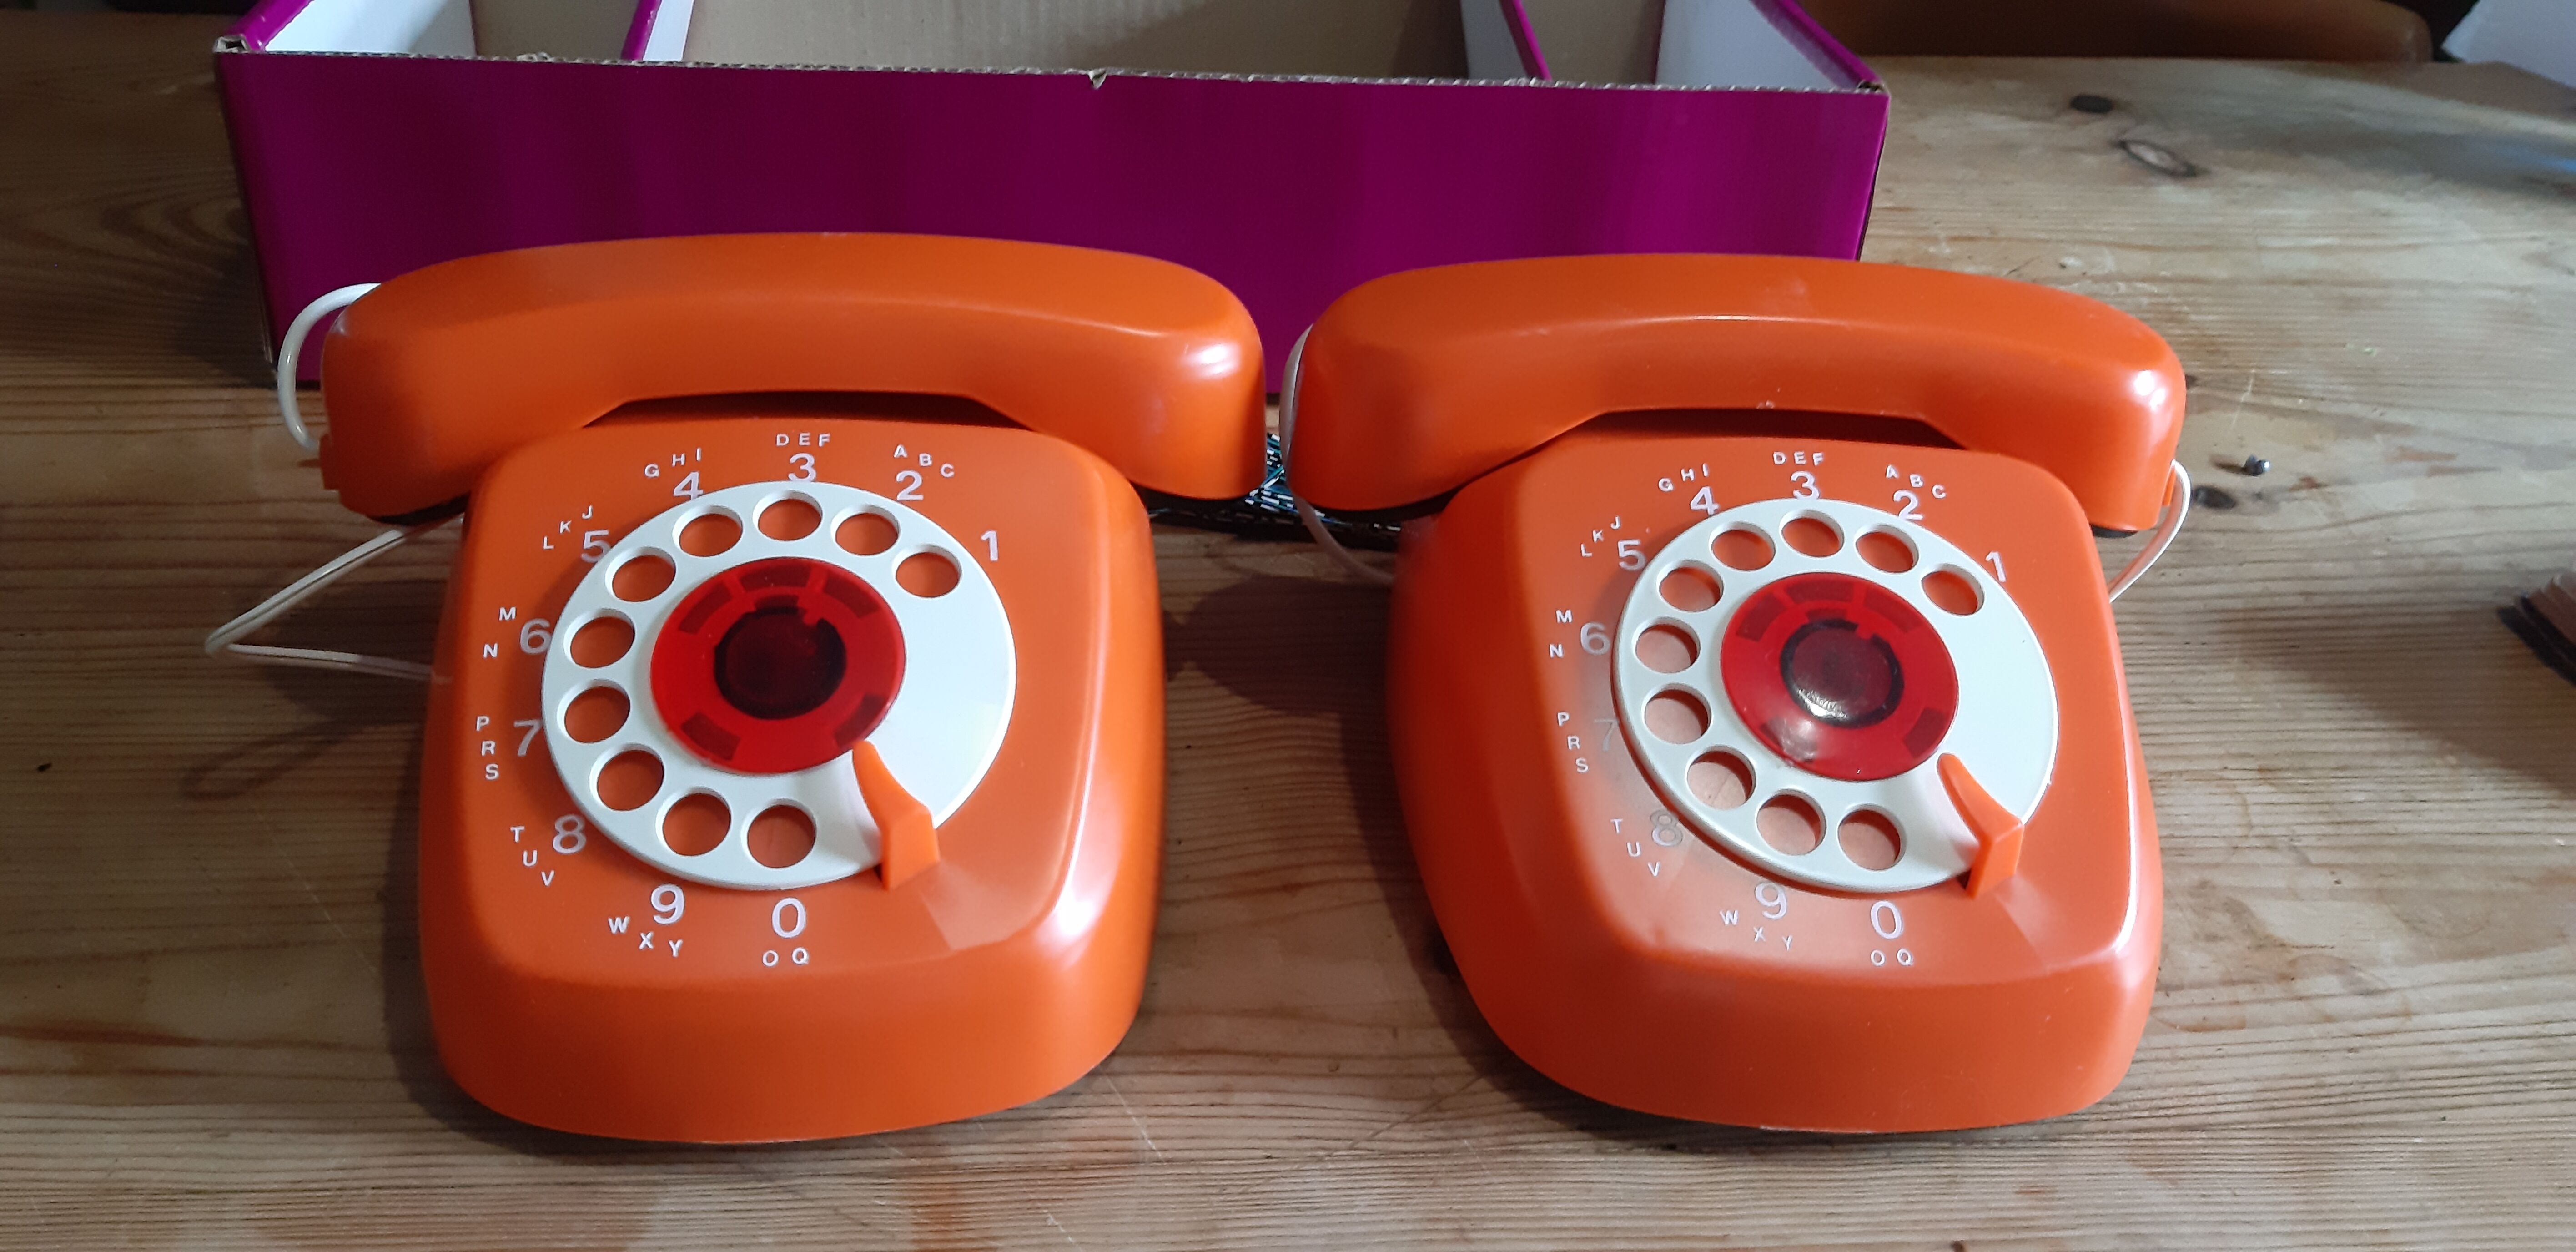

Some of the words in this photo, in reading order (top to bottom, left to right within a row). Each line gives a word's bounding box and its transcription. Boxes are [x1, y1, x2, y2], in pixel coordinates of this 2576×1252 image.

[788, 453, 817, 482] 3
[672, 471, 703, 499] 4
[896, 471, 925, 500] 2
[1689, 487, 1719, 515] 4
[1790, 471, 1819, 500] 3
[1893, 491, 1923, 521] 2
[581, 530, 610, 563] 5
[981, 531, 999, 561] 1
[1618, 539, 1645, 571] 5
[1985, 551, 2006, 581] 1
[519, 619, 552, 654] 6
[1580, 623, 1610, 655] 6
[513, 721, 542, 756] 7
[1594, 719, 1618, 751] 7
[553, 815, 586, 855] 8
[1650, 809, 1683, 847] 8
[651, 885, 685, 924] 9
[1755, 883, 1787, 919] 9
[772, 899, 807, 938] 0
[1871, 901, 1903, 939] 0
